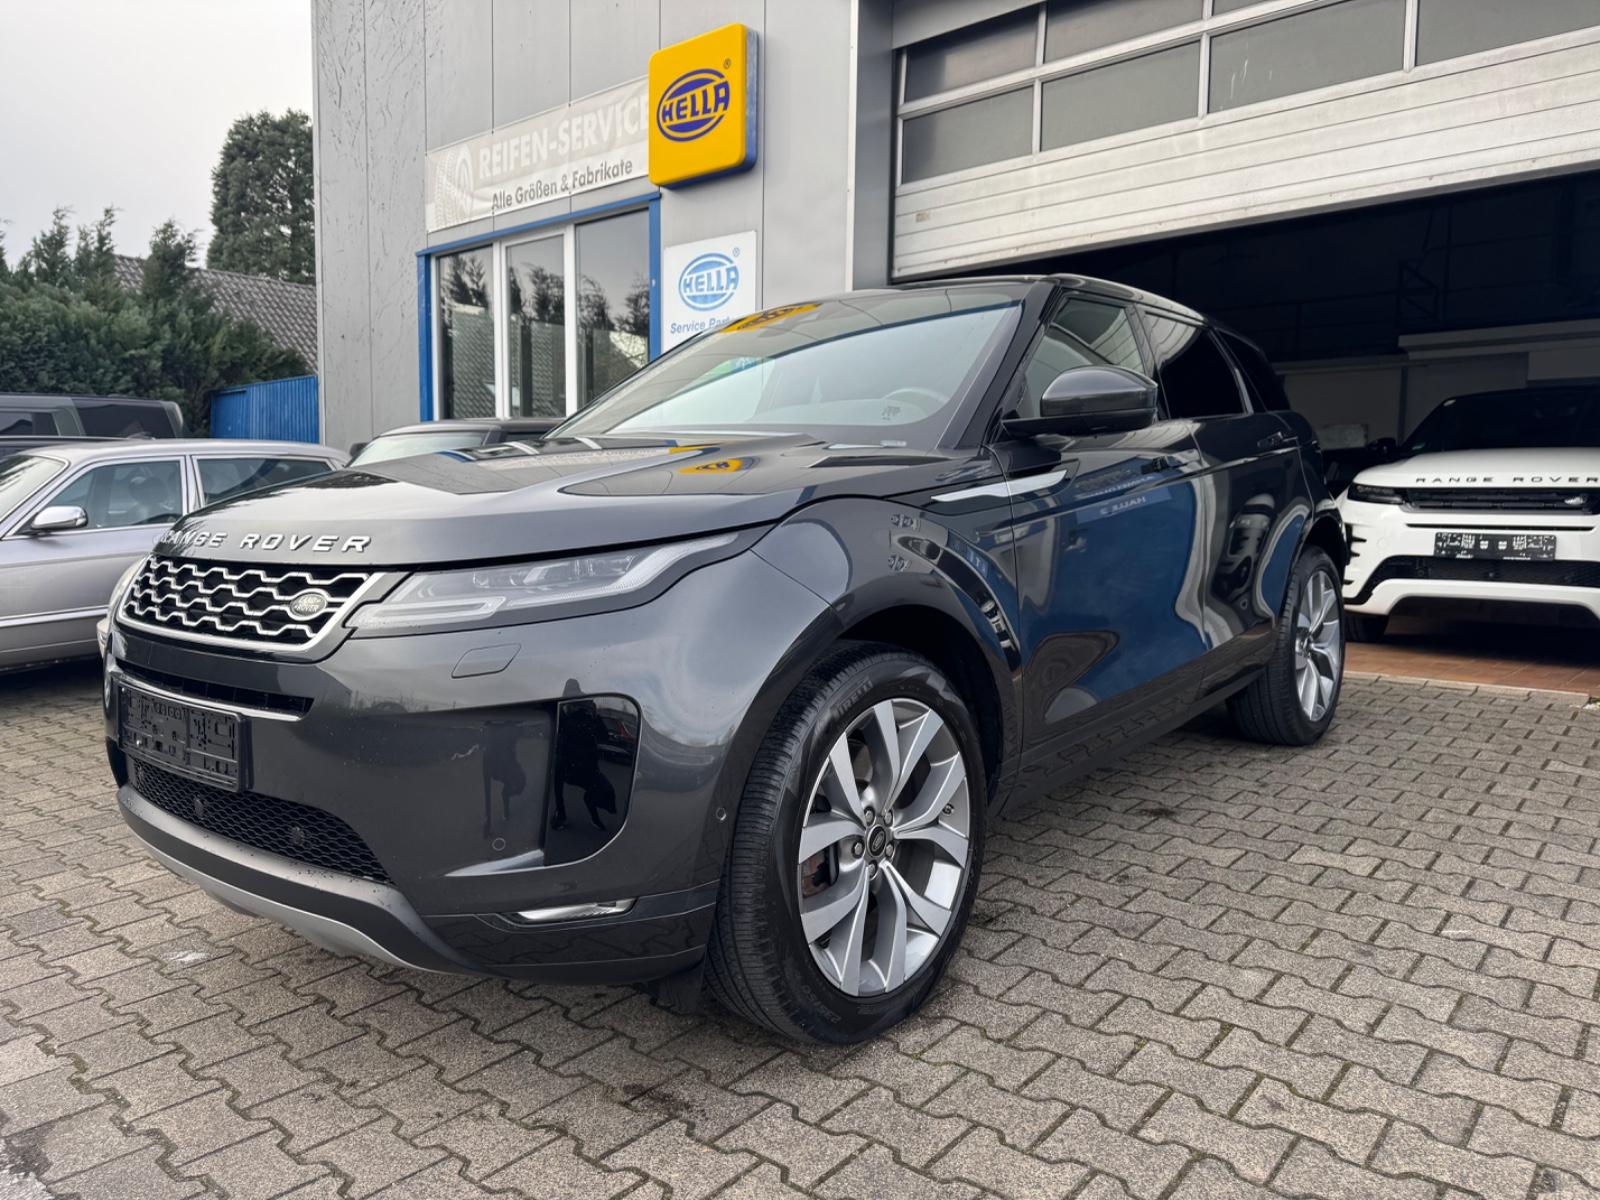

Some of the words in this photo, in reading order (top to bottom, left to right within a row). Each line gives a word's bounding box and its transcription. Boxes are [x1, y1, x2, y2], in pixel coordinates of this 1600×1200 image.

[661, 80, 730, 123] HELLA
[491, 193, 513, 210] Alle
[515, 180, 558, 204] Größen
[560, 174, 570, 191] &
[572, 160, 633, 189] Fabrikate
[683, 266, 740, 294] HELLA
[670, 321, 706, 334] Service
[239, 533, 372, 553] ROVER
